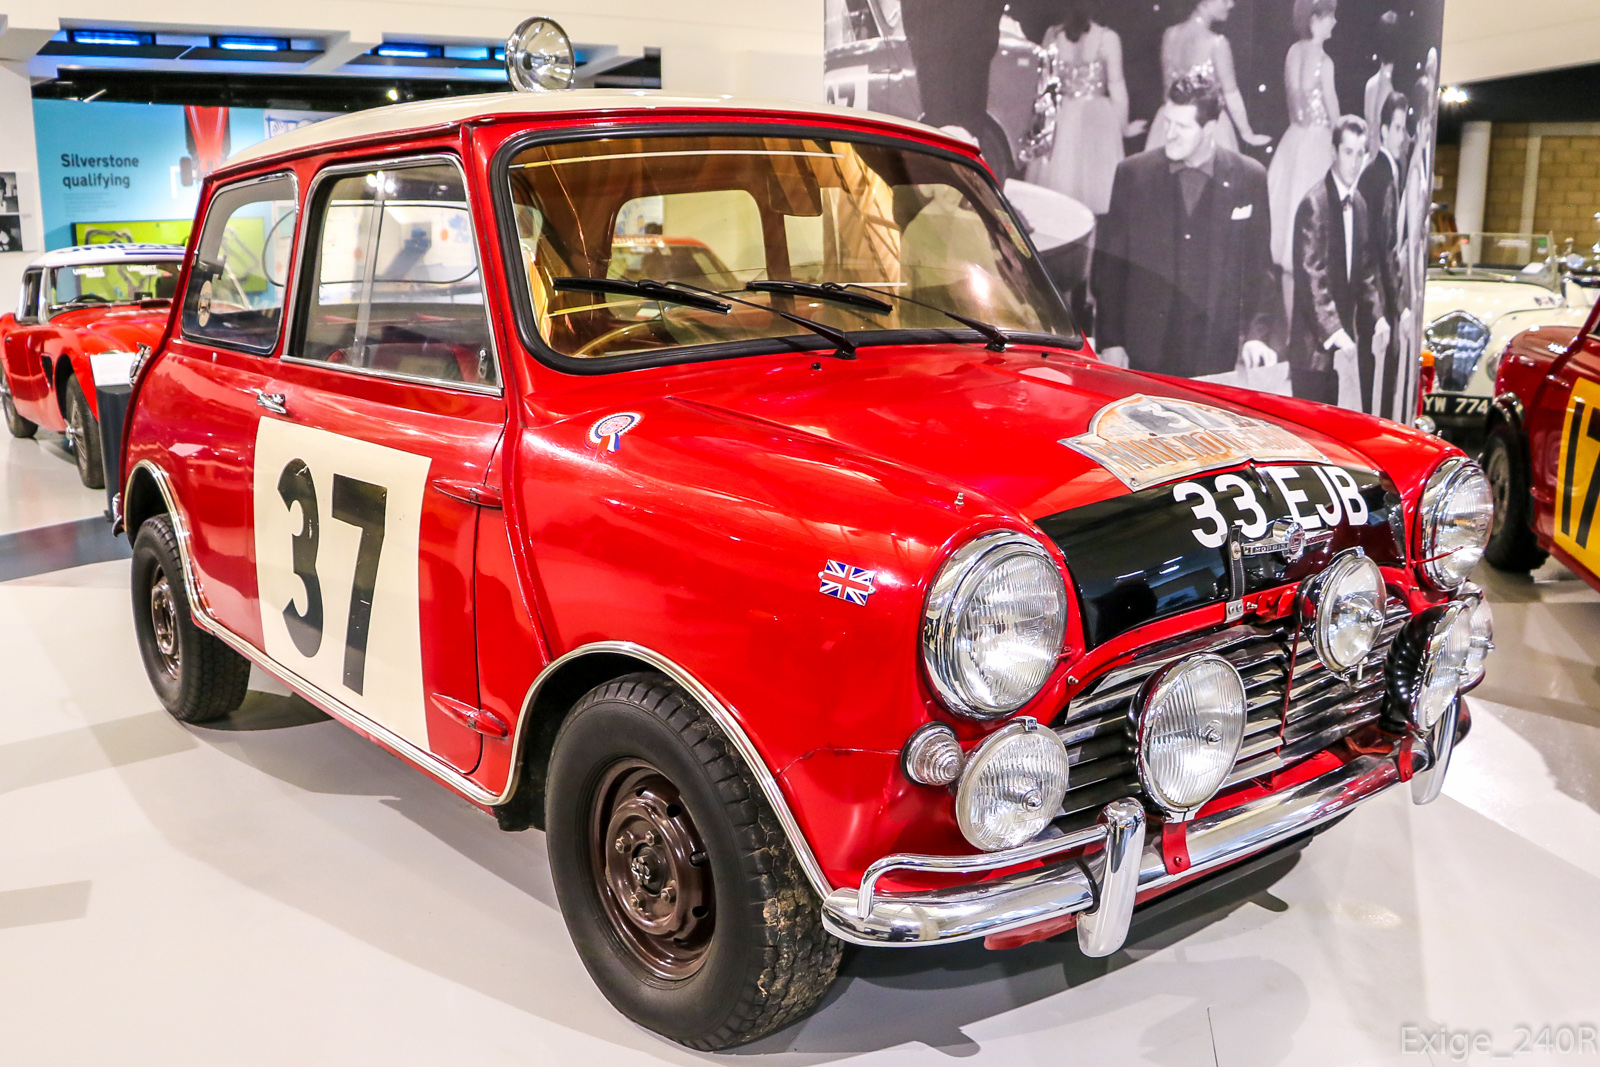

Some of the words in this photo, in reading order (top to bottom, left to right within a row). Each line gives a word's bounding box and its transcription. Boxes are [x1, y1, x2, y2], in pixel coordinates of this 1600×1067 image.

[61, 153, 139, 168] Silverstone
[63, 173, 131, 189] qualifying
[1455, 398, 1489, 414] 774
[1173, 474, 1268, 548] 33
[1266, 466, 1369, 530] EJB
[277, 457, 388, 697] 37
